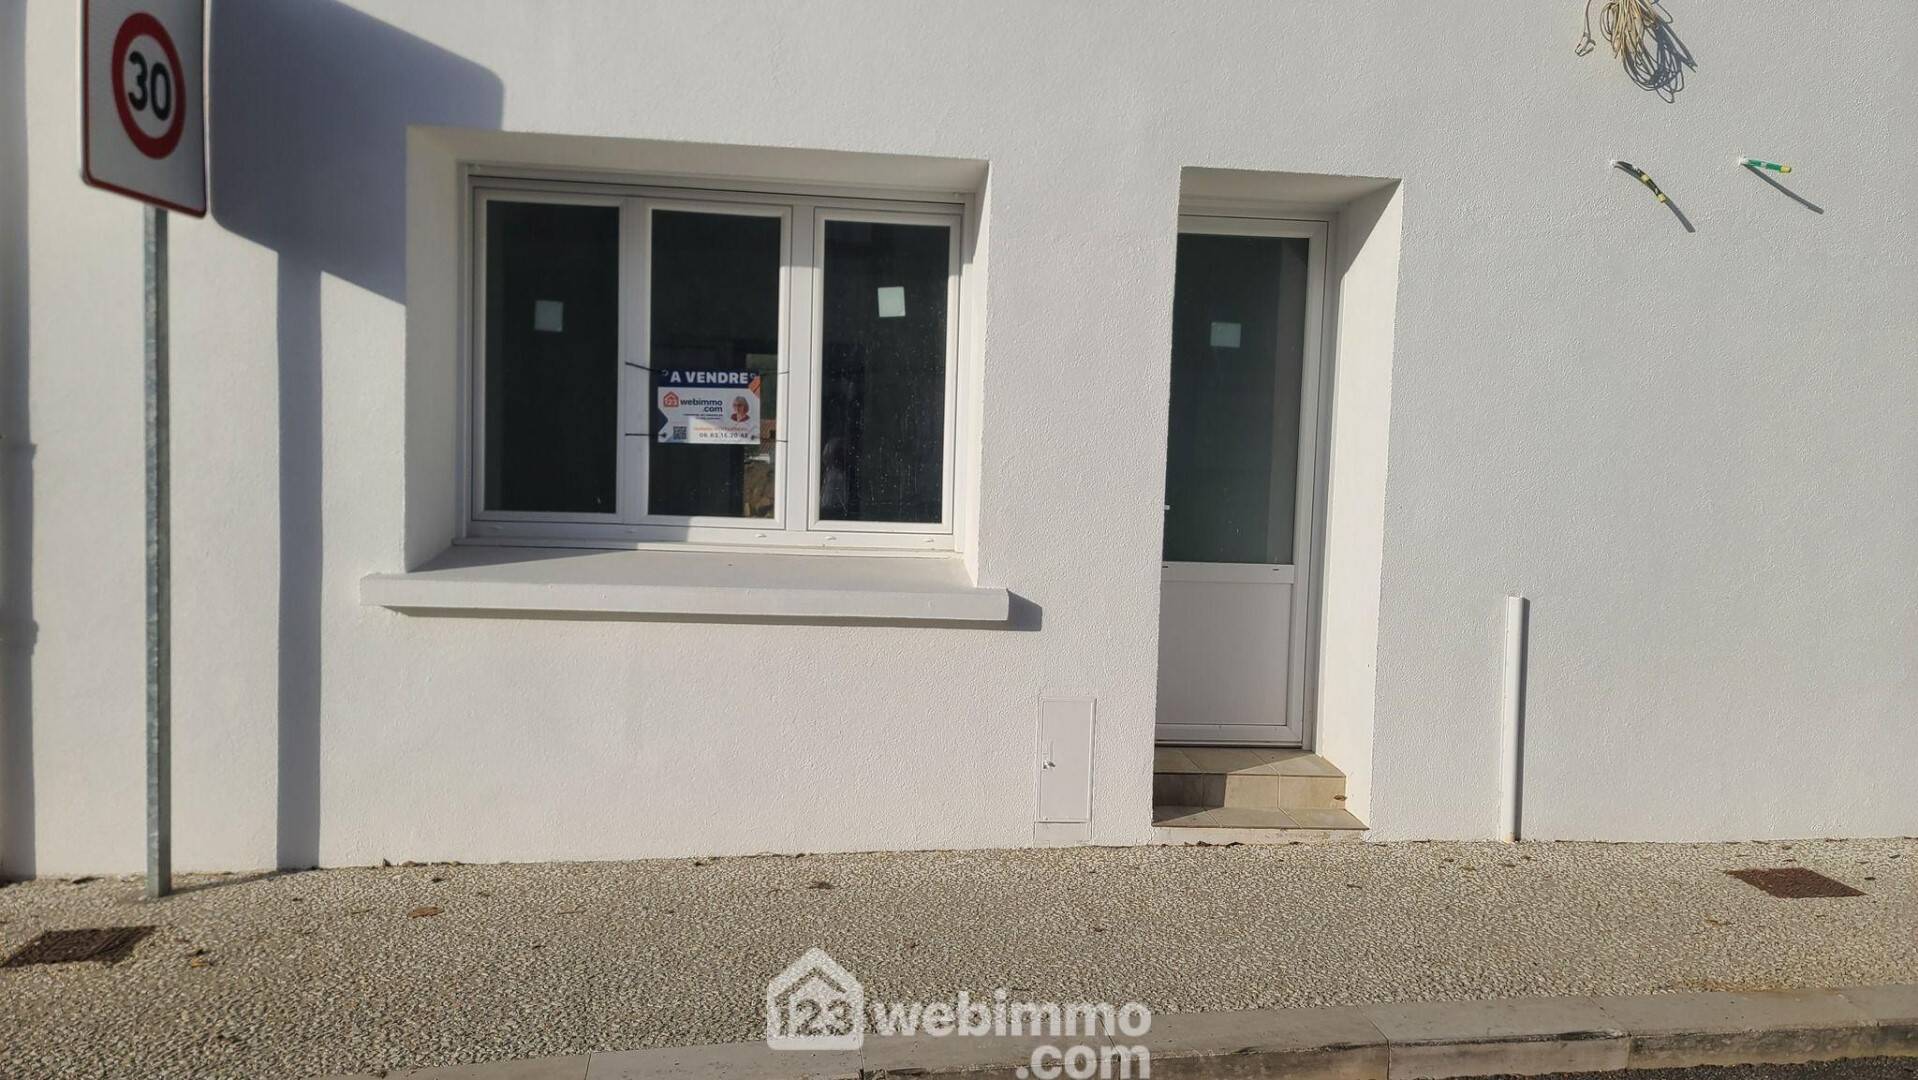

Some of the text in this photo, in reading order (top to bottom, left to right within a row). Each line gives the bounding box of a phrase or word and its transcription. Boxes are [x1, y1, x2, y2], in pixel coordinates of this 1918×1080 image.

[128, 50, 172, 121] 30
[670, 371, 748, 384] A VENDRE
[680, 398, 723, 406] webimmo
